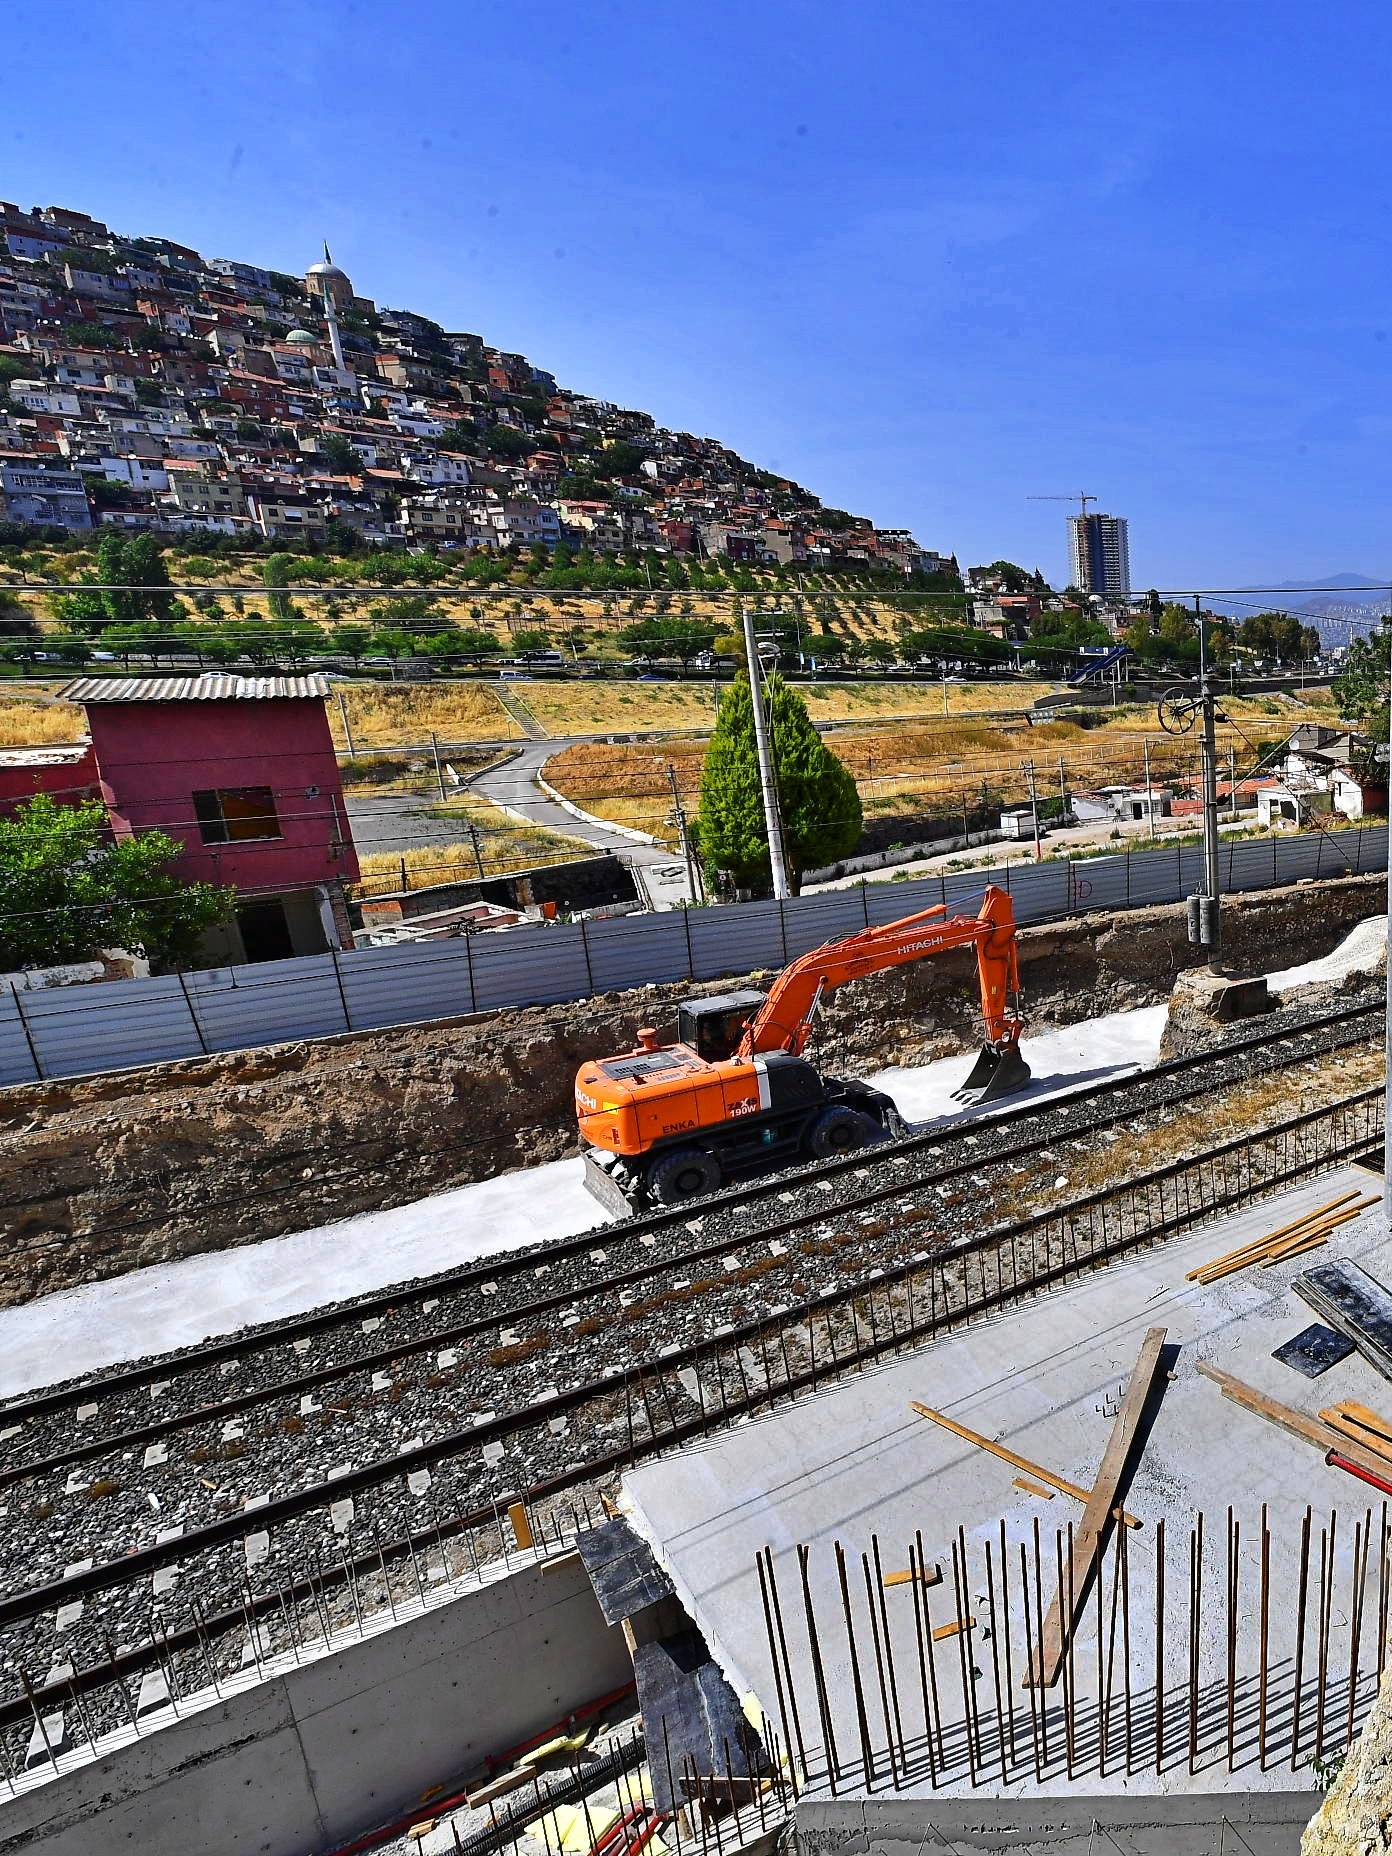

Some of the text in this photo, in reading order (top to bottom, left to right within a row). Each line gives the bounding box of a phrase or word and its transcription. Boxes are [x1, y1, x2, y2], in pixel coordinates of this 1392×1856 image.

[897, 935, 944, 955] HITACHI
[729, 1104, 757, 1118] 190W
[662, 1119, 696, 1134] ENKA
